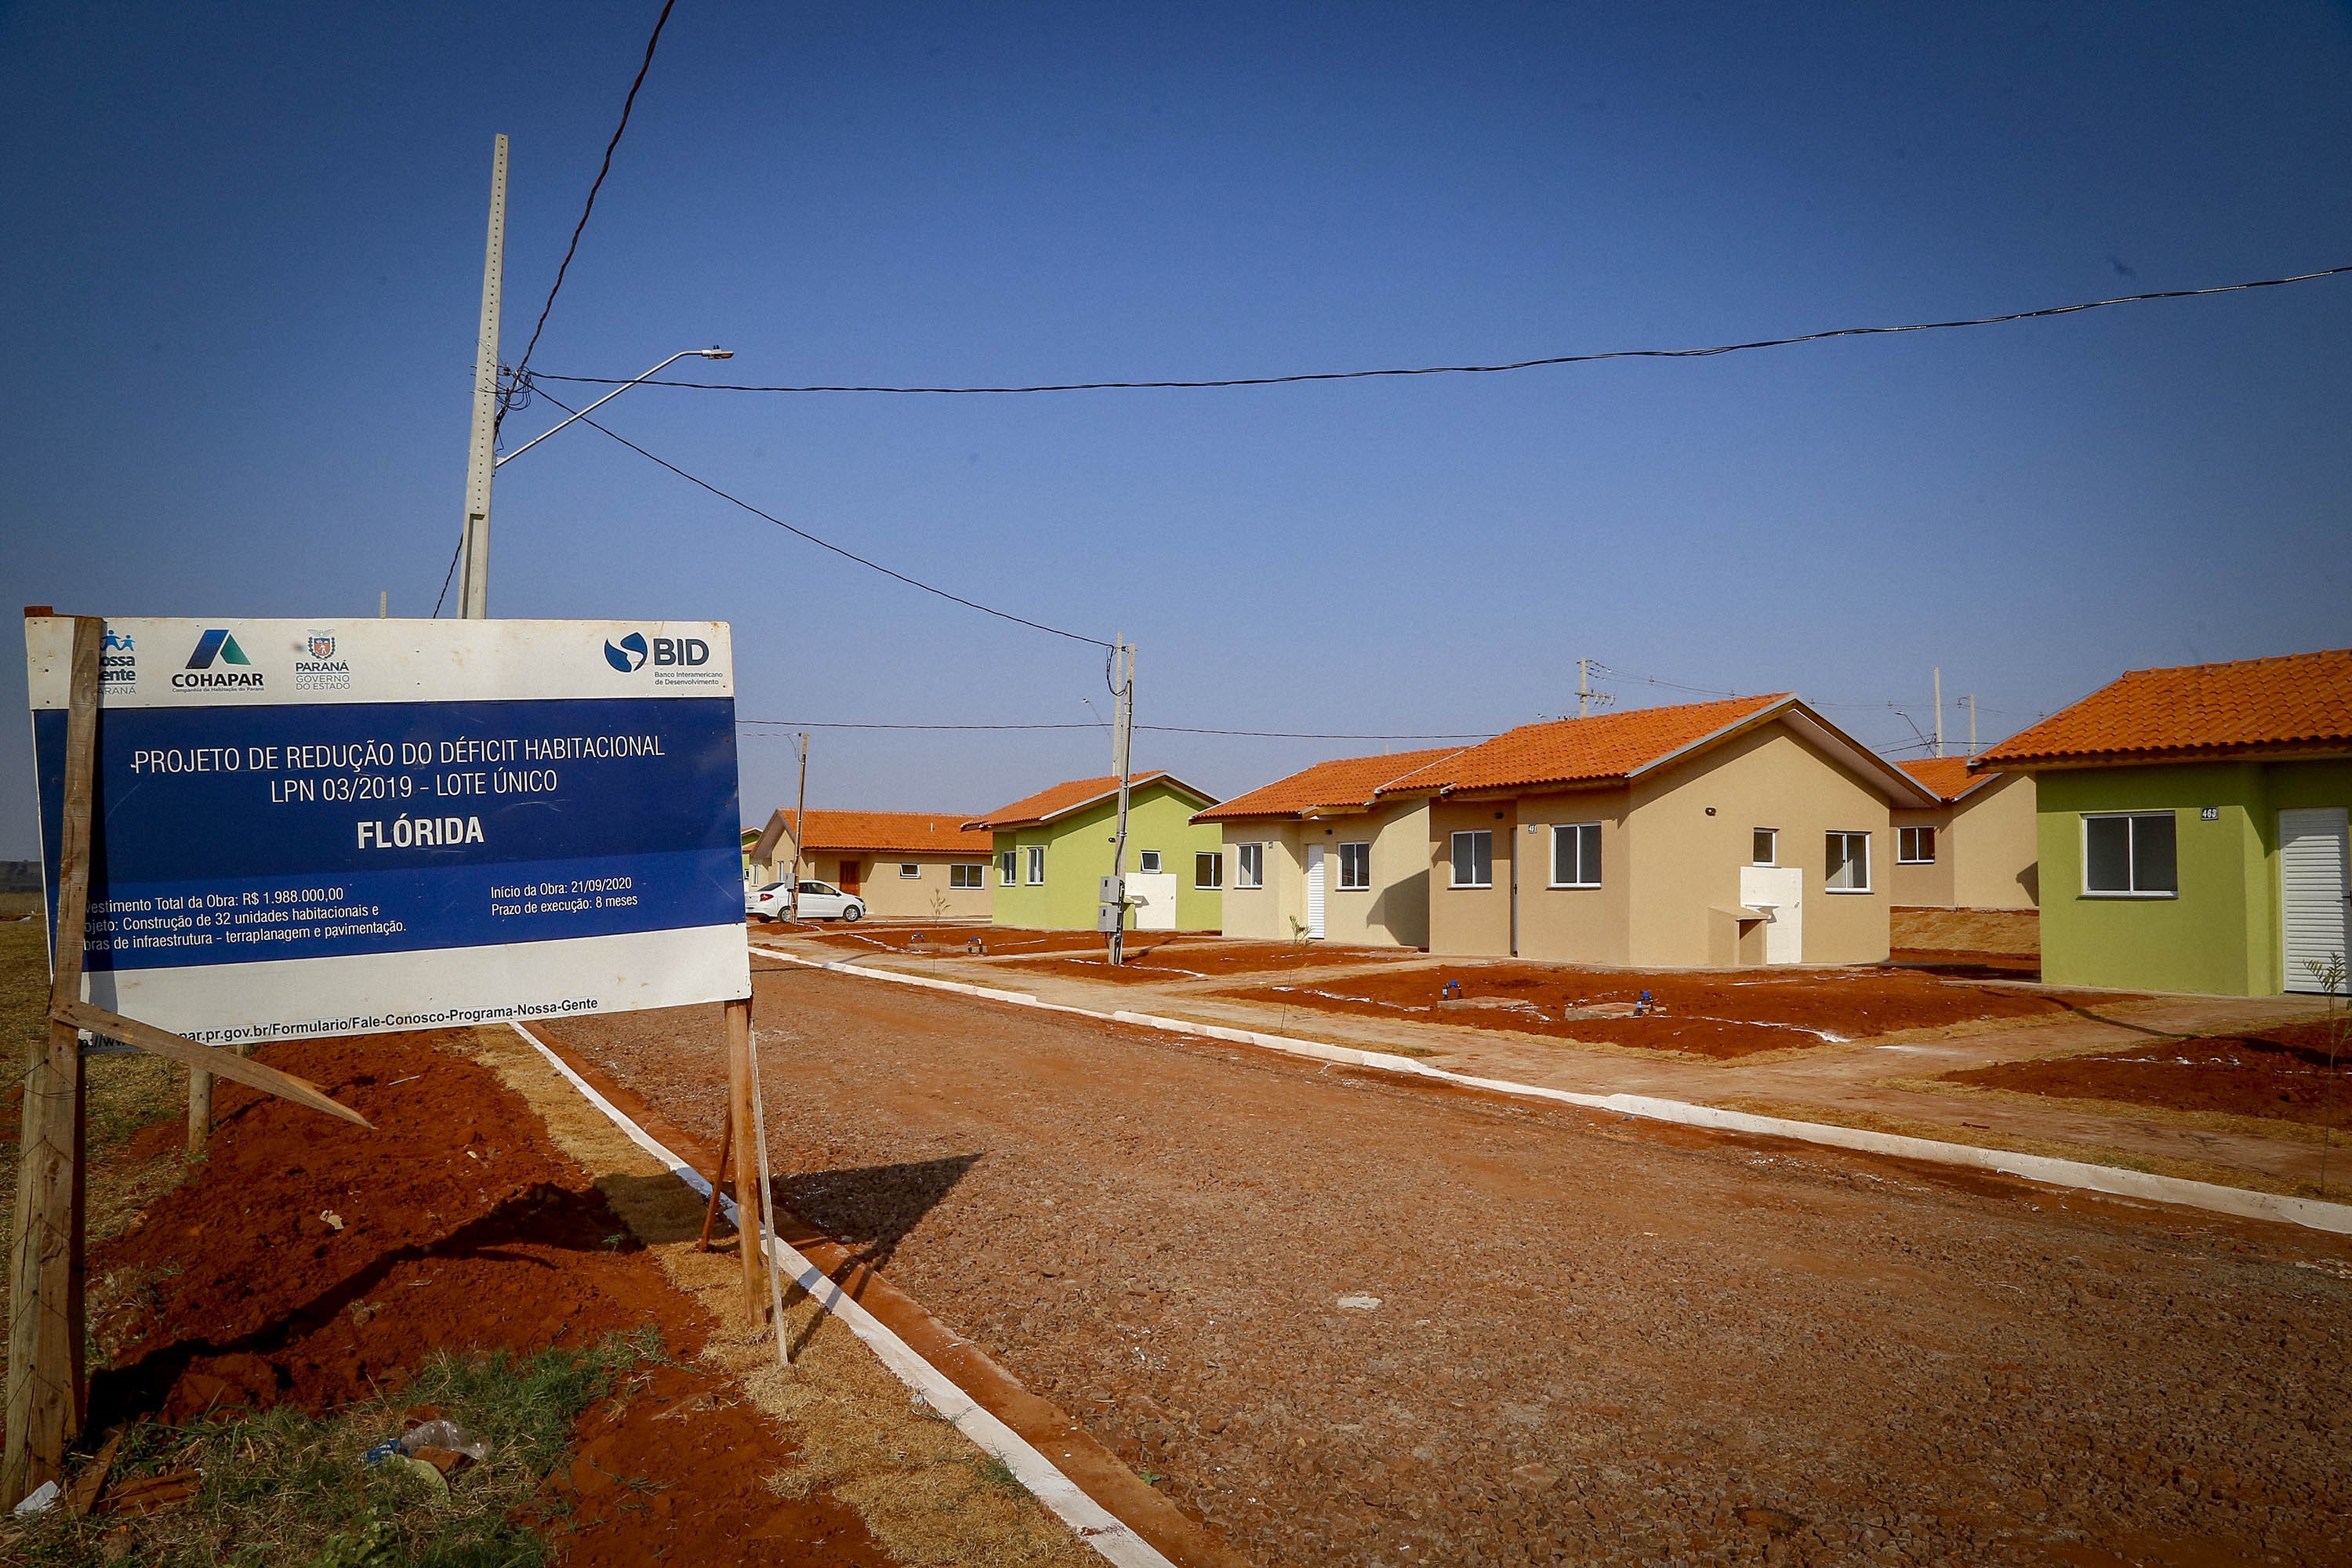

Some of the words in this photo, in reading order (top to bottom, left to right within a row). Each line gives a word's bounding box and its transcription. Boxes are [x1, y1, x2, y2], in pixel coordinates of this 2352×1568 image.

[100, 655, 136, 666] ossa
[653, 638, 710, 666] BID
[100, 669, 136, 681] ente
[296, 659, 350, 672] PARANÁ
[172, 673, 264, 687] COHAPAR
[296, 674, 350, 683] GOVERNO
[134, 747, 241, 774] PROJETO
[248, 746, 279, 771] DE
[286, 739, 394, 772] REDUÇÃO
[401, 742, 433, 765] DO
[439, 735, 518, 764] DÉFICIT
[524, 735, 666, 760] HABITACIONAL
[270, 779, 314, 803] LPN
[321, 775, 413, 802] 03/2019
[436, 771, 486, 797] LOTE
[493, 766, 558, 794] ÚNICO
[2202, 808, 2217, 818] 463
[357, 811, 485, 850] FLÓRIDA
[154, 896, 184, 910] Total
[187, 895, 203, 909] da
[206, 893, 239, 908] Obra:
[242, 891, 260, 906] R$
[263, 887, 344, 905] 1.988.000,00
[491, 884, 521, 899] Início
[524, 884, 537, 897] da
[539, 883, 568, 896] Obra:
[571, 876, 633, 894] 21/09/2020
[492, 902, 521, 916] Prazo
[524, 901, 538, 914] de
[540, 898, 593, 913] execução:
[595, 895, 603, 909] 8
[605, 895, 639, 908] meses
[122, 915, 193, 931] Construção
[196, 913, 212, 927] de
[215, 912, 232, 926] 32
[234, 909, 289, 924] unidades
[292, 904, 369, 921] habitacionais
[372, 905, 379, 916] e
[113, 935, 129, 949] de
[132, 932, 213, 949] infraestrutura
[225, 927, 311, 945] terraplanagem
[314, 927, 321, 938] e
[324, 919, 407, 939] pavimentação.
